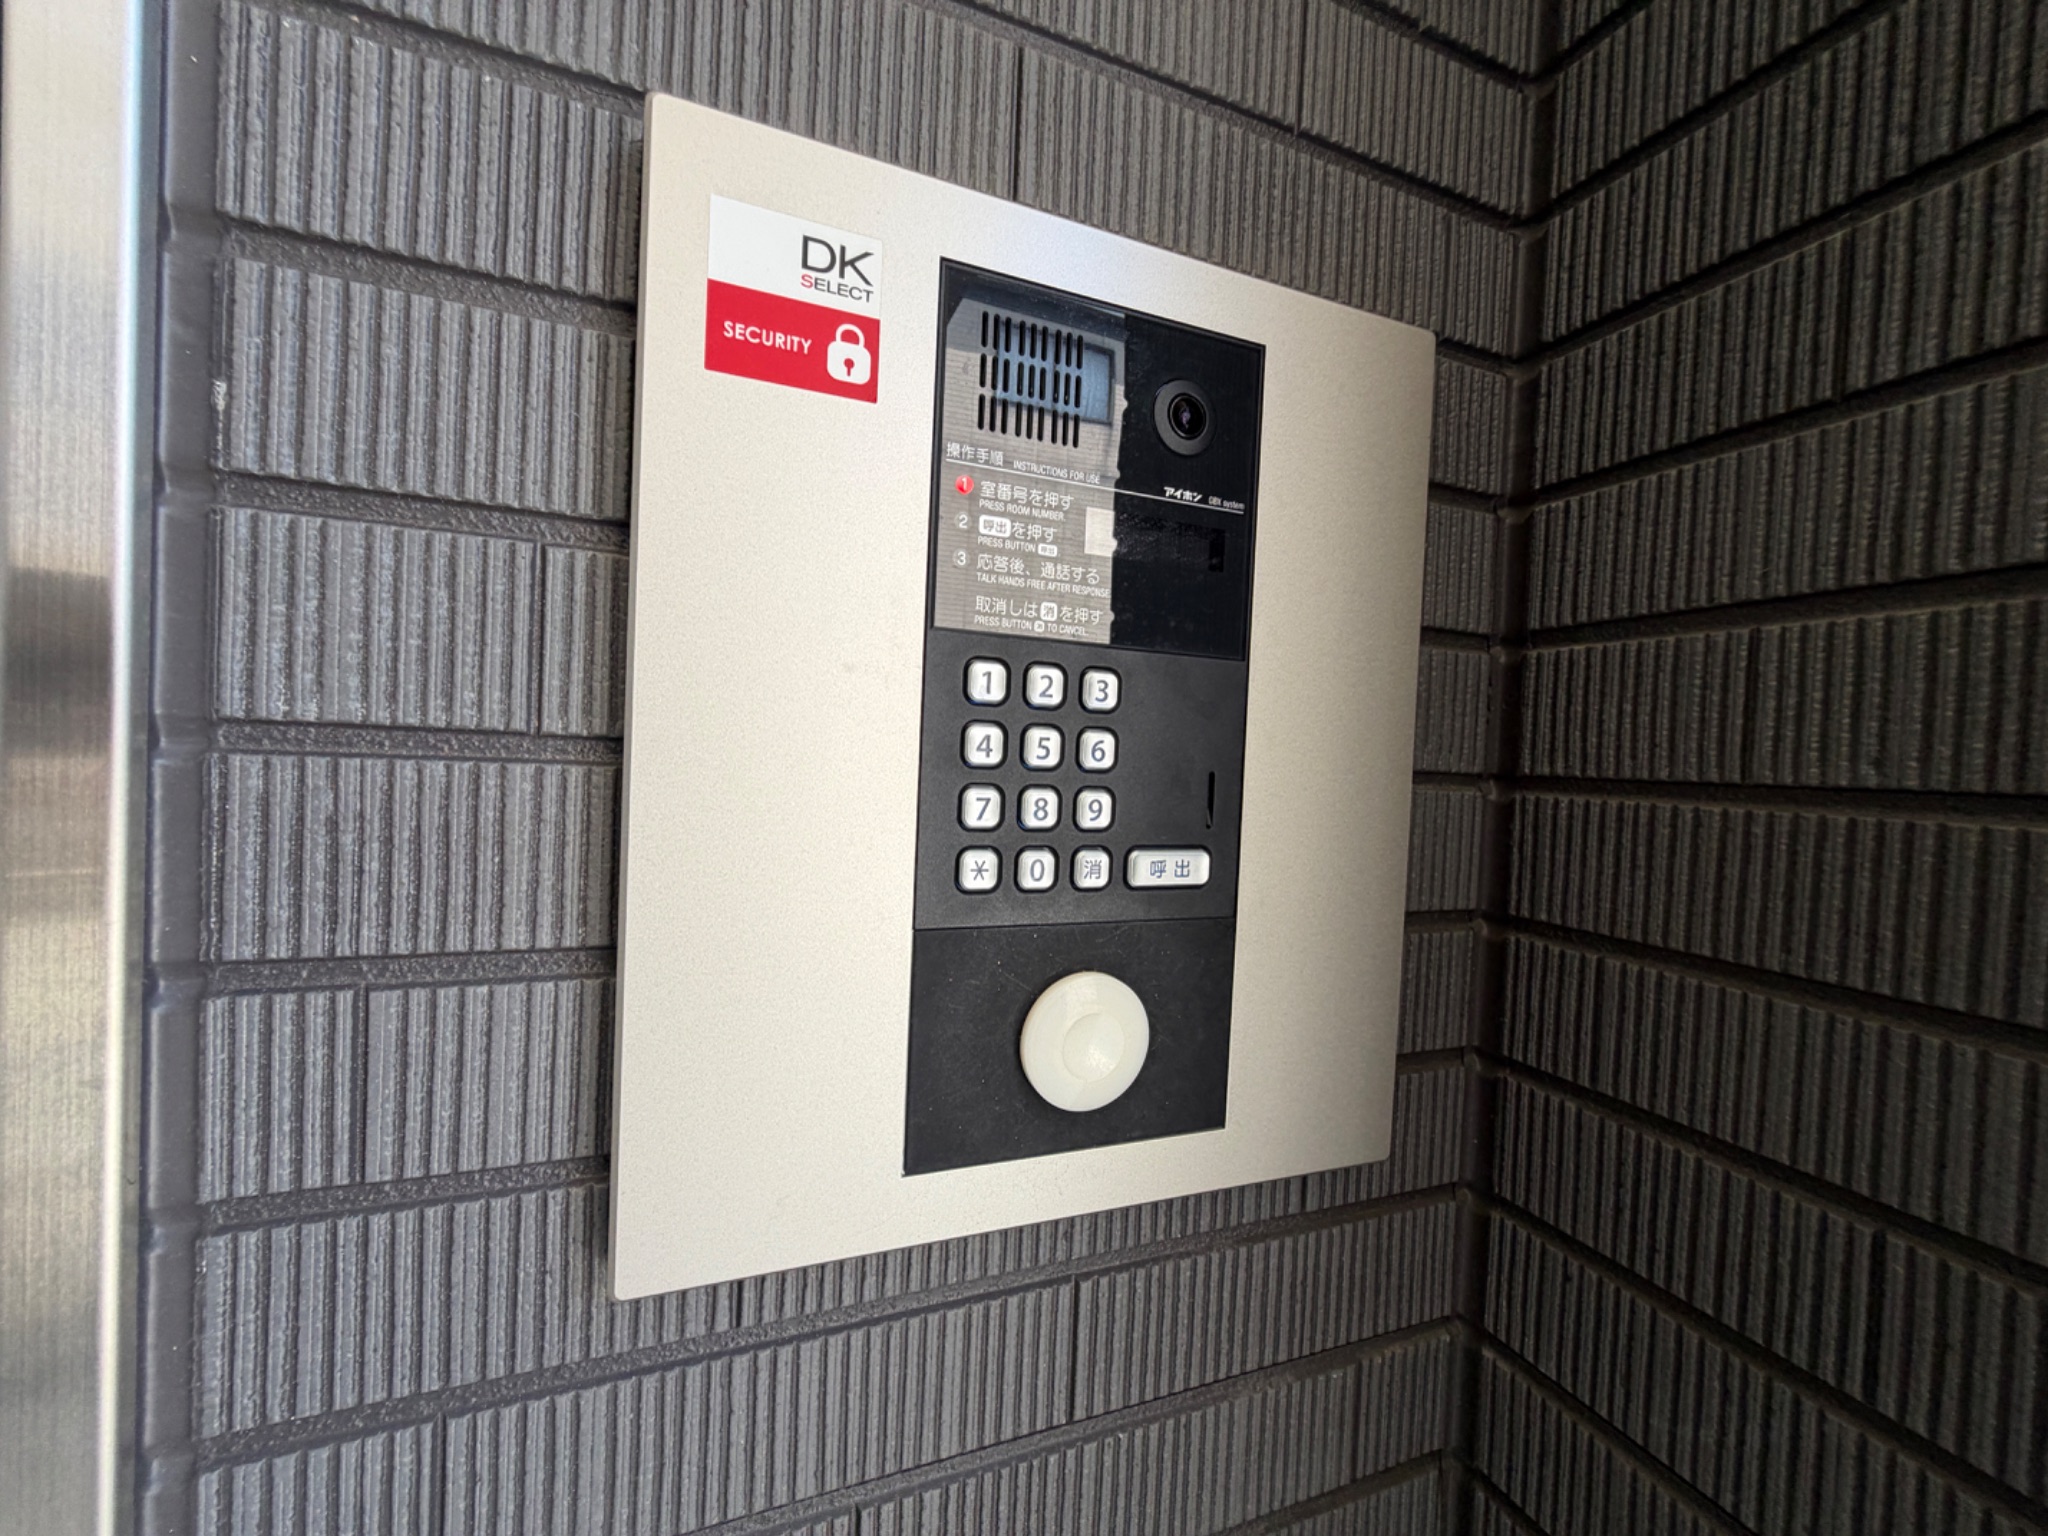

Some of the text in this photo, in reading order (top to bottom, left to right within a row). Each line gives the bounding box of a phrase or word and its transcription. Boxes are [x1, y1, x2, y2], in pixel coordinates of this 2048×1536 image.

[801, 234, 874, 287] DK
[800, 273, 873, 303] SELECT
[723, 320, 812, 355] SECURITY
[946, 442, 1004, 467] 操作手順
[1013, 460, 1100, 484] INSTRUCTIONS FOR USE
[980, 481, 1075, 511] 室番号を押す
[1163, 486, 1203, 503] アイホン
[958, 513, 969, 530] 2
[979, 499, 1066, 522] PRESS ROOM NUMBER.
[977, 536, 1003, 549] PRESS
[1004, 540, 1036, 553] BUTTON
[957, 551, 967, 566] 3
[976, 572, 997, 584] TALK
[998, 575, 1025, 588] HANDS
[1026, 579, 1045, 590] FREE
[1047, 582, 1071, 593] AFTER
[974, 615, 999, 627] PRESS
[1001, 618, 1032, 631] BUTTON
[1047, 623, 1058, 634] TO
[981, 671, 1109, 702] 1 2 3
[976, 734, 1106, 762] 4 5 6
[975, 797, 1103, 822] 7 8 9
[1030, 859, 1045, 882] 0
[1084, 859, 1103, 880] 消
[1149, 859, 1191, 879] 呼出
